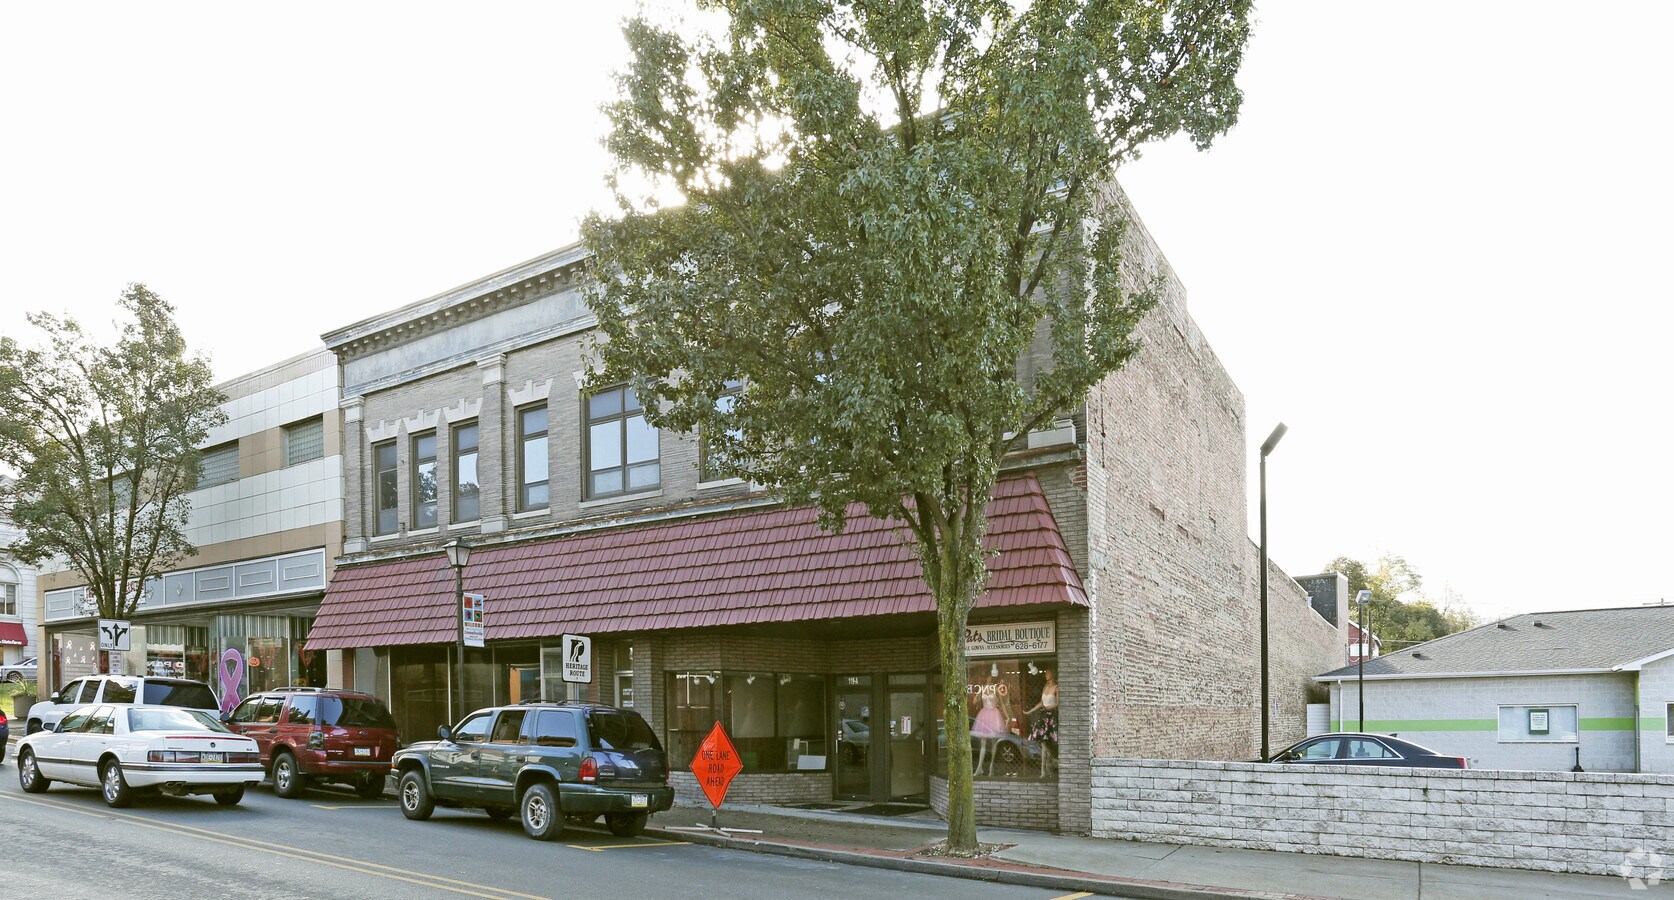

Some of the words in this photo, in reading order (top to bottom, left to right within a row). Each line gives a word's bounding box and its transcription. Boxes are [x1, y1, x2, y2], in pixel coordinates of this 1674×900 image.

[987, 630, 1012, 642] BRIDAL
[1015, 627, 1050, 641] BOUTIQUE
[1015, 641, 1048, 650] 628-6177
[565, 663, 589, 671] HERITAGE
[702, 750, 714, 760] ONE
[716, 750, 730, 760] LANE
[708, 763, 725, 774] ROAD
[706, 777, 725, 787] AHEAD
